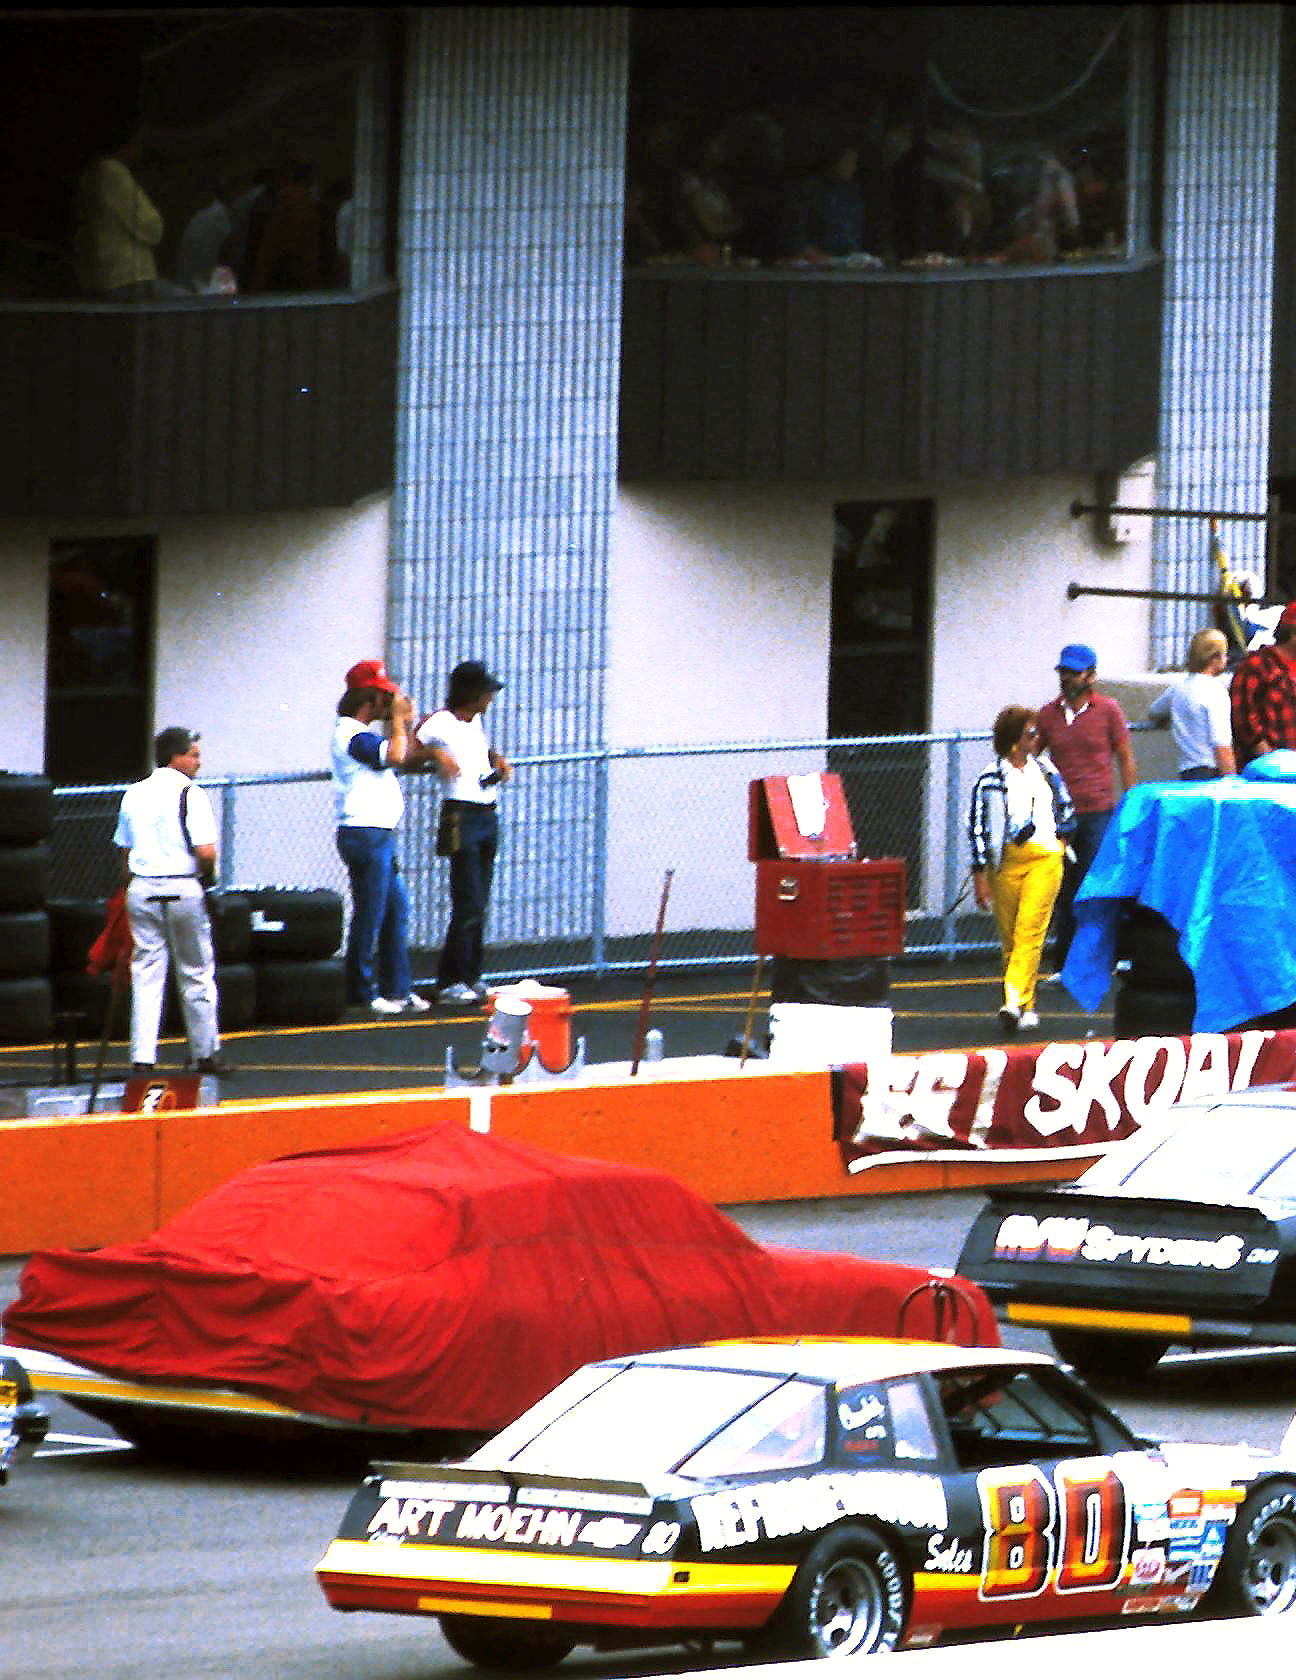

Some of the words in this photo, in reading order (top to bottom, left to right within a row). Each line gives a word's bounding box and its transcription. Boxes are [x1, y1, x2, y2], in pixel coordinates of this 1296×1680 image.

[366, 1498, 456, 1537] ART
[455, 1503, 582, 1546] MOEHN
[977, 1453, 1133, 1604] 80
